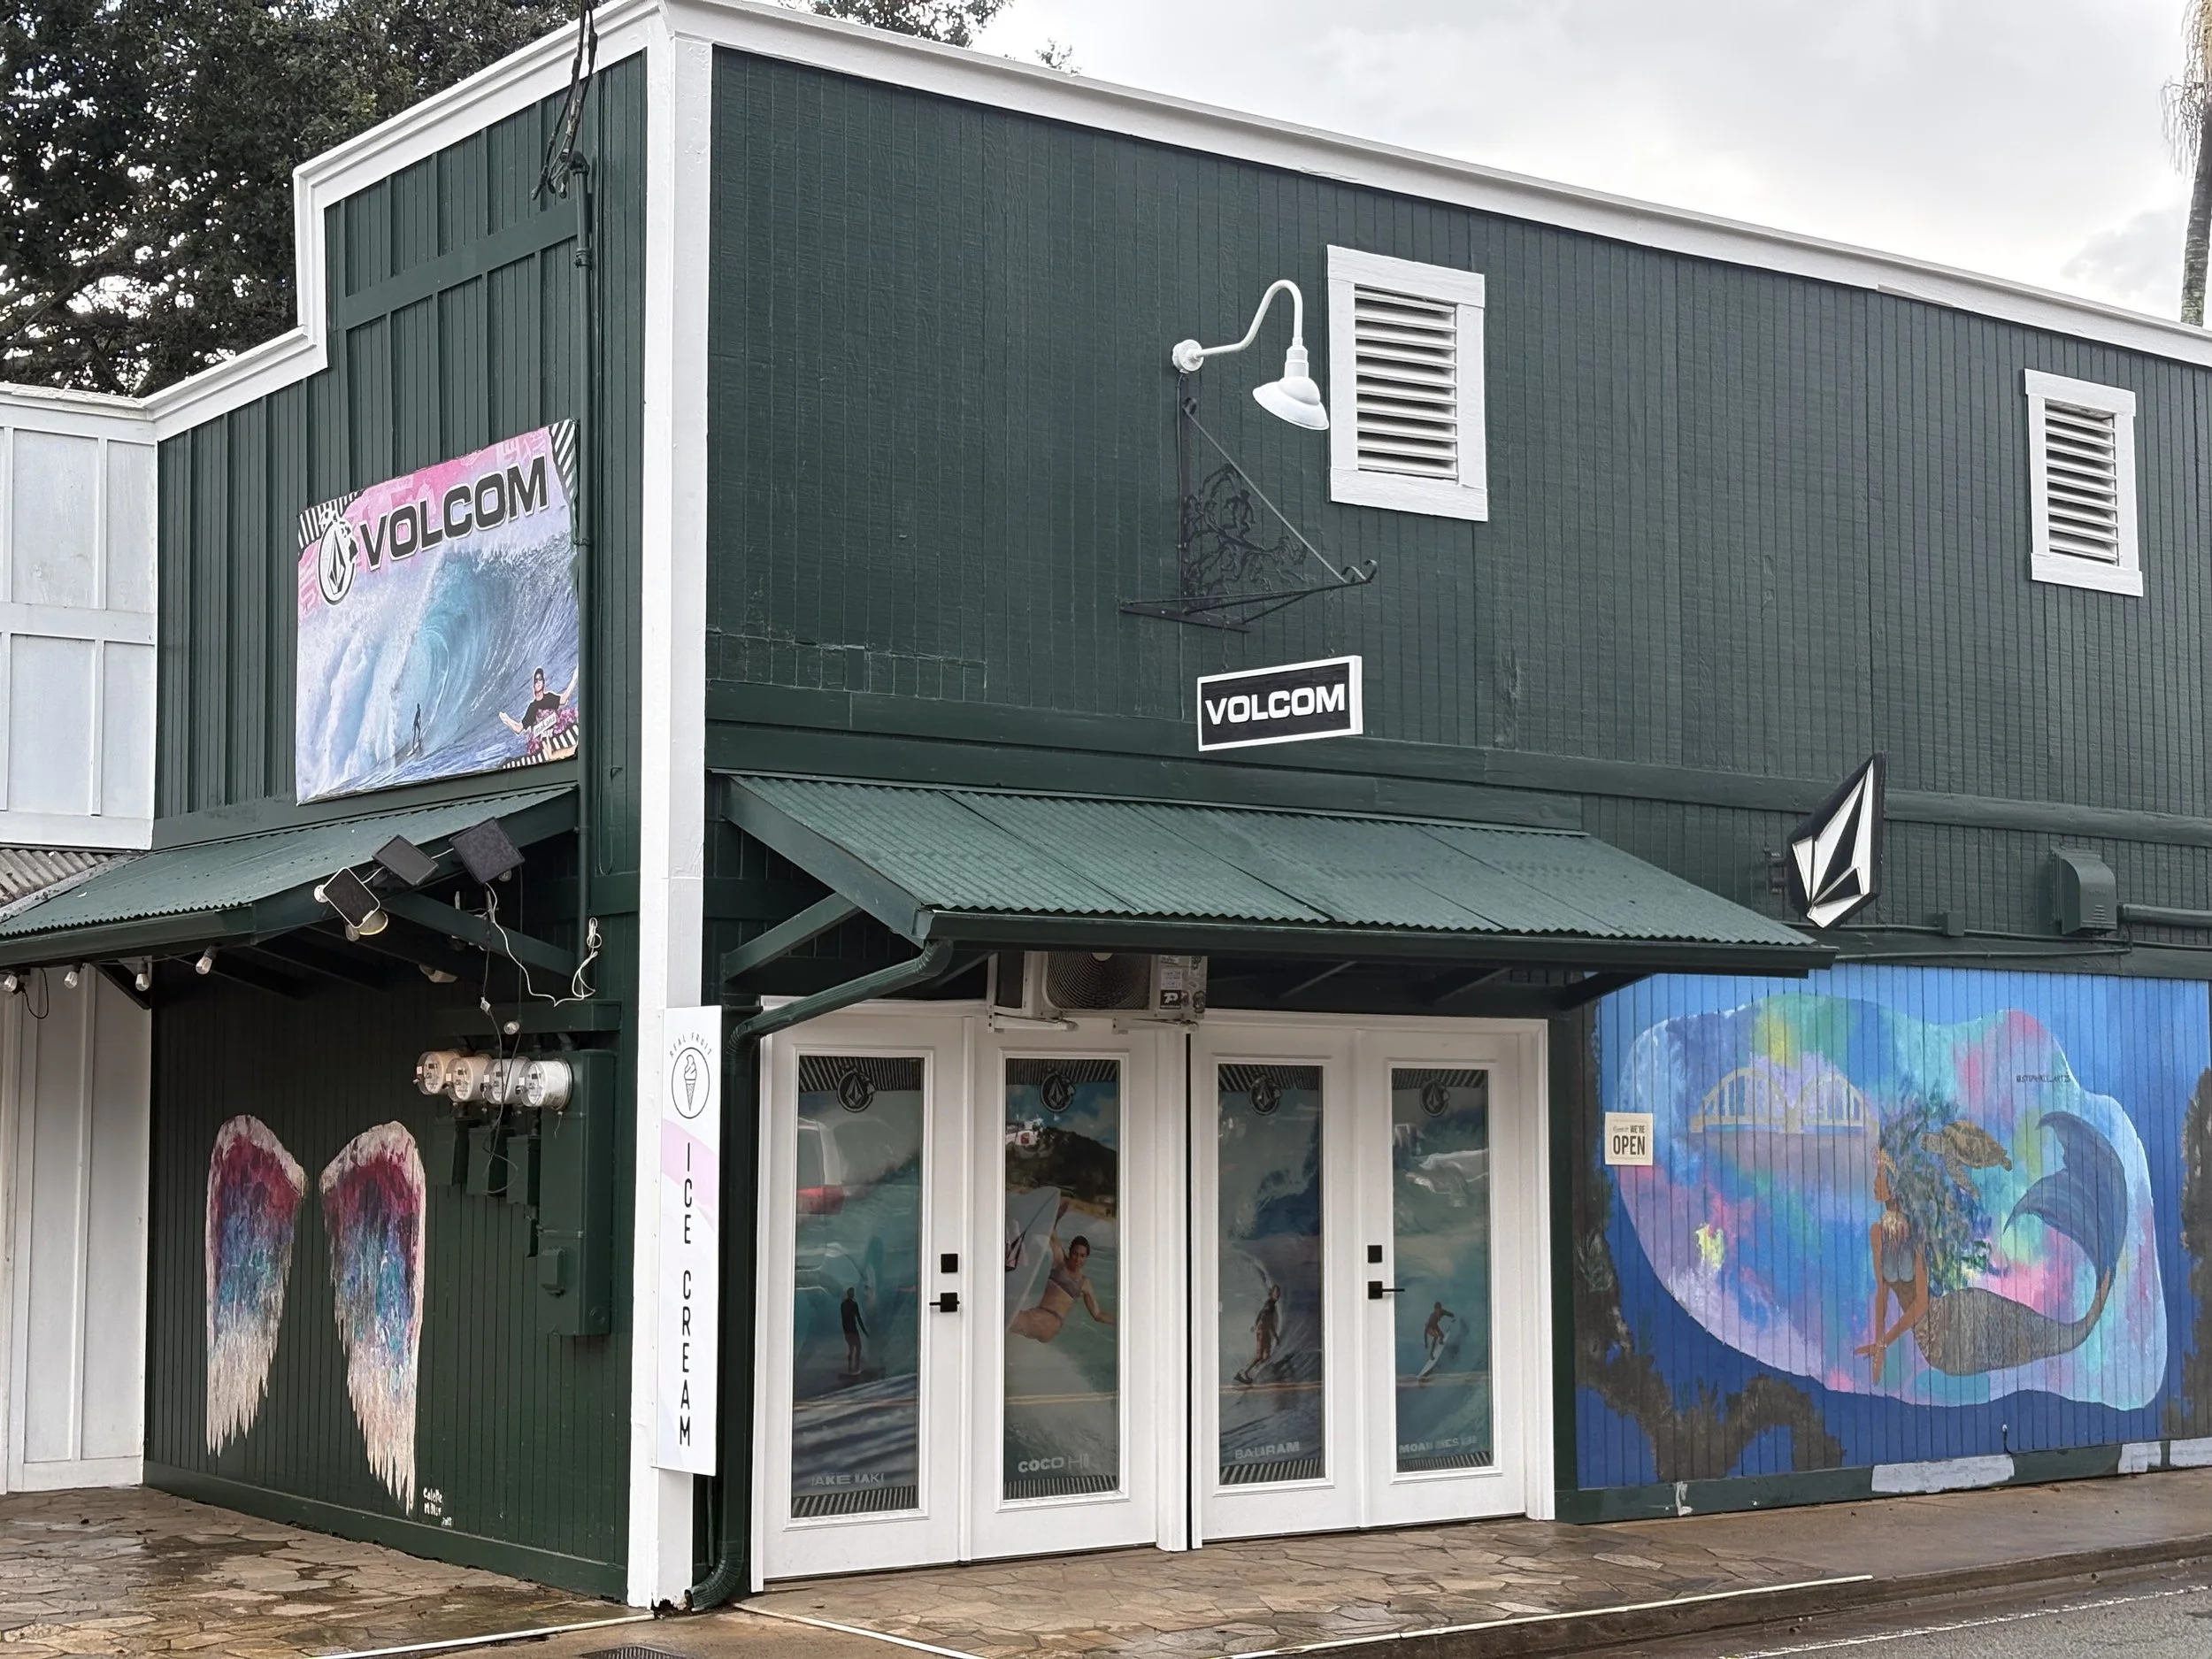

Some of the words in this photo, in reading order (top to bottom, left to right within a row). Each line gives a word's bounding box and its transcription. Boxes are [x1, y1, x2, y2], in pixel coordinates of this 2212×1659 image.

[359, 455, 549, 571] VOLCOM
[1205, 683, 1345, 726] VOLCOM
[669, 1033, 687, 1059] REAL
[690, 1032, 712, 1056] FRUIT
[1613, 1134, 1646, 1156] OPEN
[682, 1141, 694, 1245] ICE
[679, 1269, 692, 1447] CREAM
[1018, 1456, 1065, 1473] COCO
